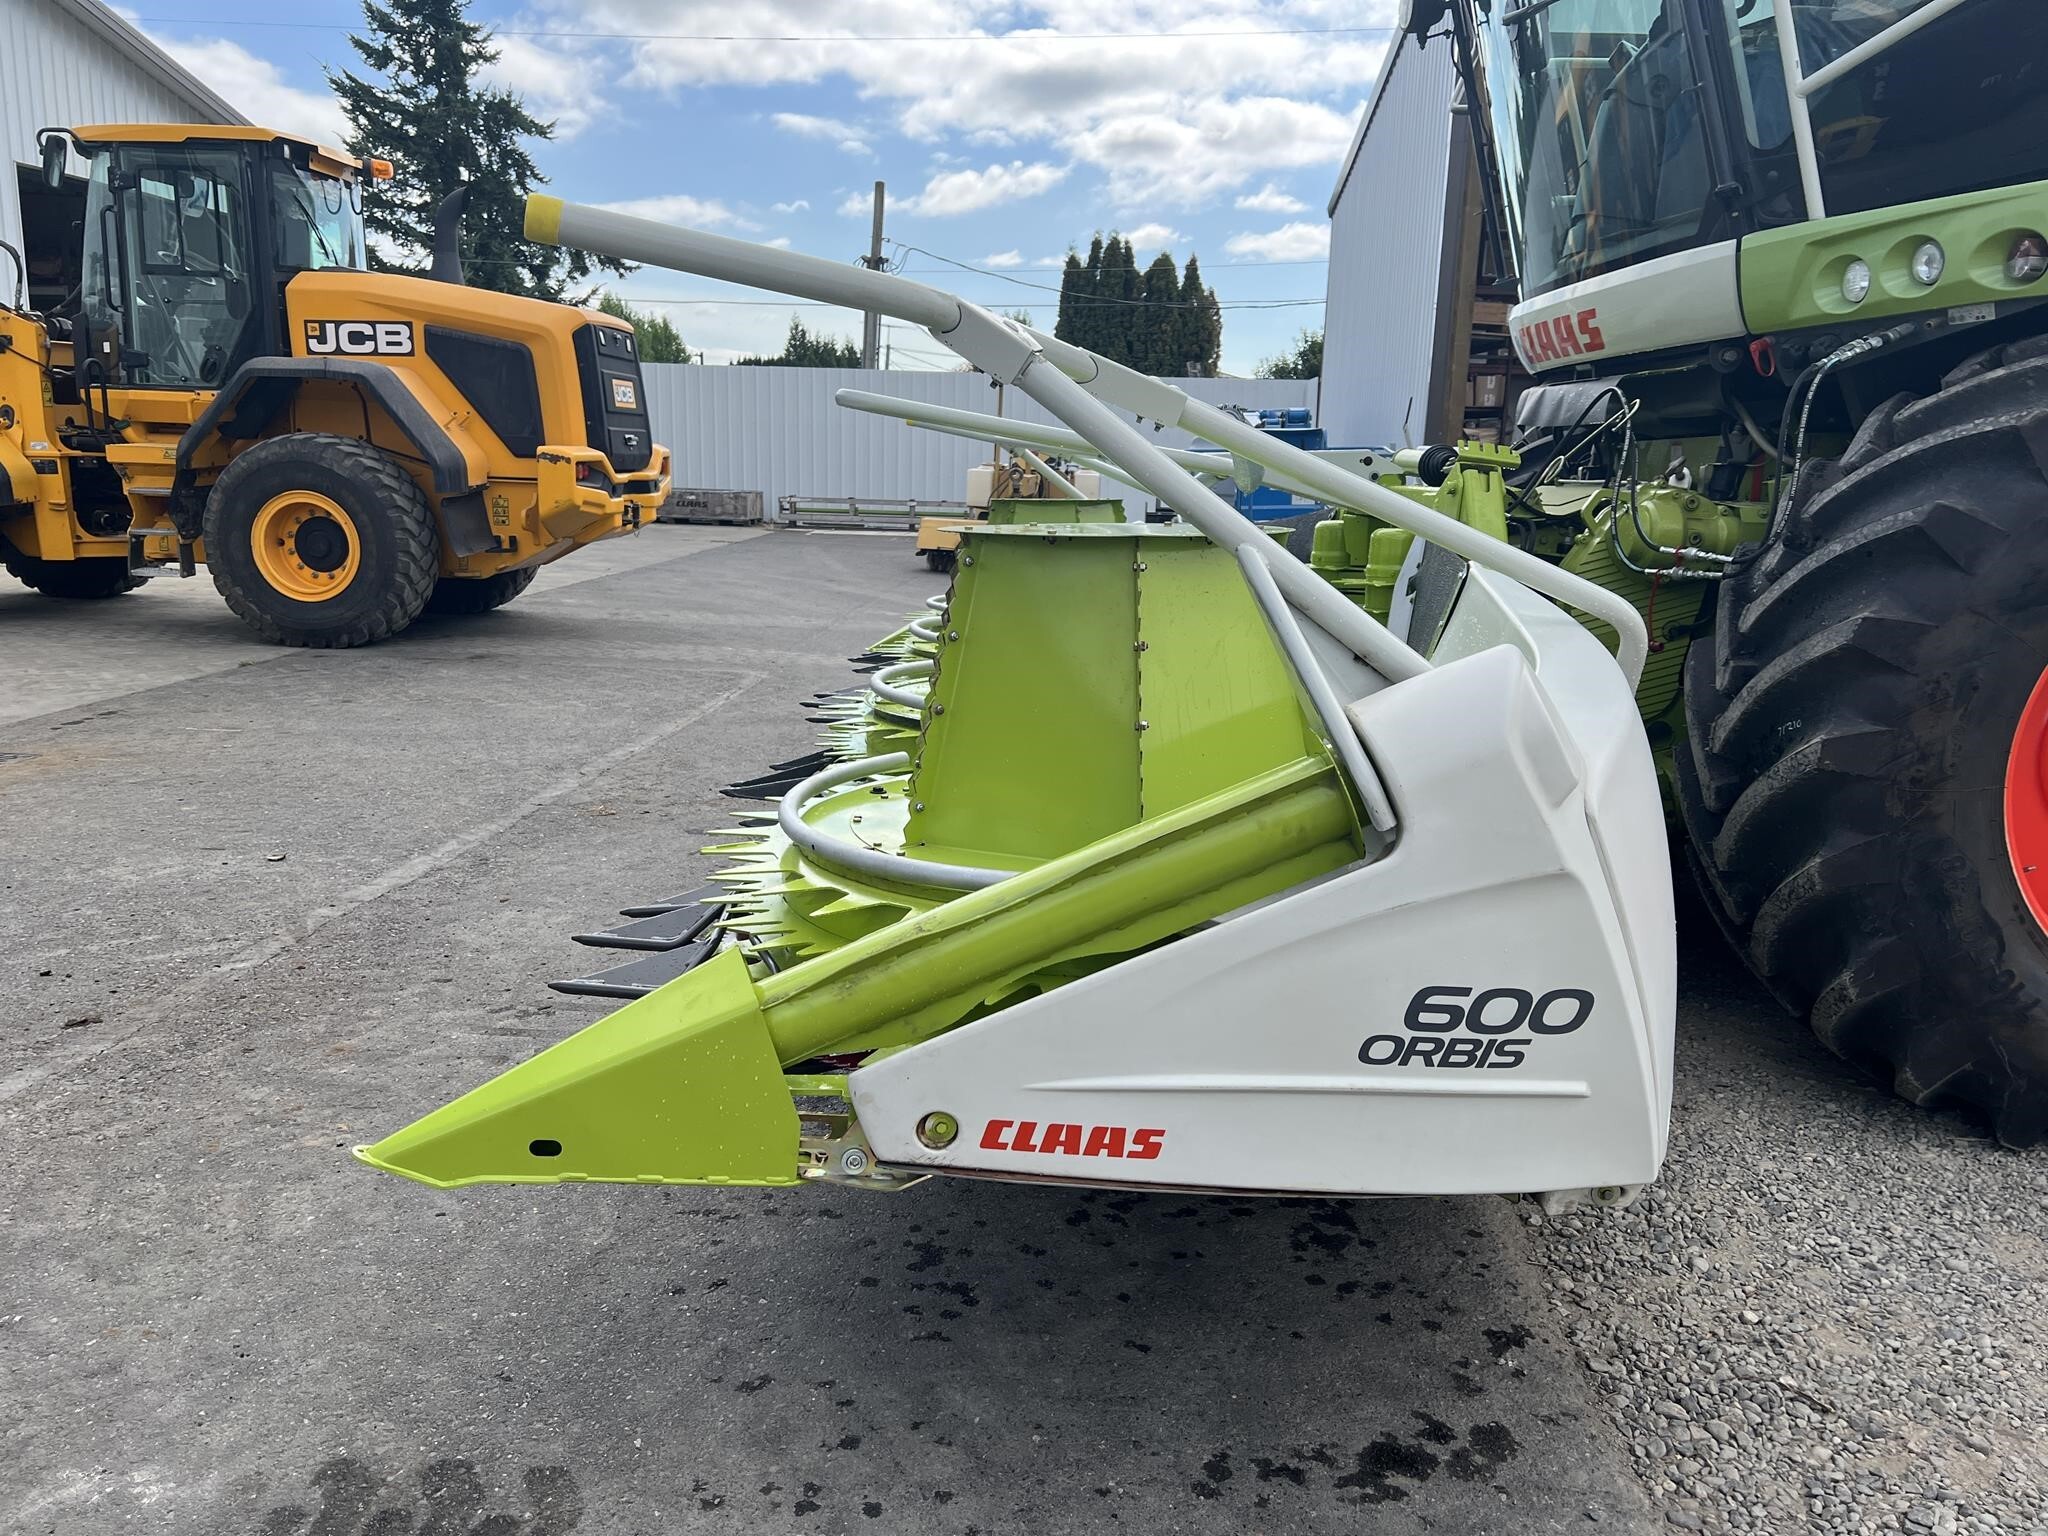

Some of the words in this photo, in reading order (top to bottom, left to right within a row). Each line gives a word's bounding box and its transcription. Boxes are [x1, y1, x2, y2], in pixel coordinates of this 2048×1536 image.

[308, 323, 412, 353] JCB
[1519, 308, 1605, 364] CLAAS
[615, 384, 634, 402] JCB
[676, 500, 708, 508] CLAAS
[1403, 985, 1595, 1035] 600
[1357, 1034, 1533, 1069] ORBIS
[979, 1119, 1166, 1160] CLAAS
